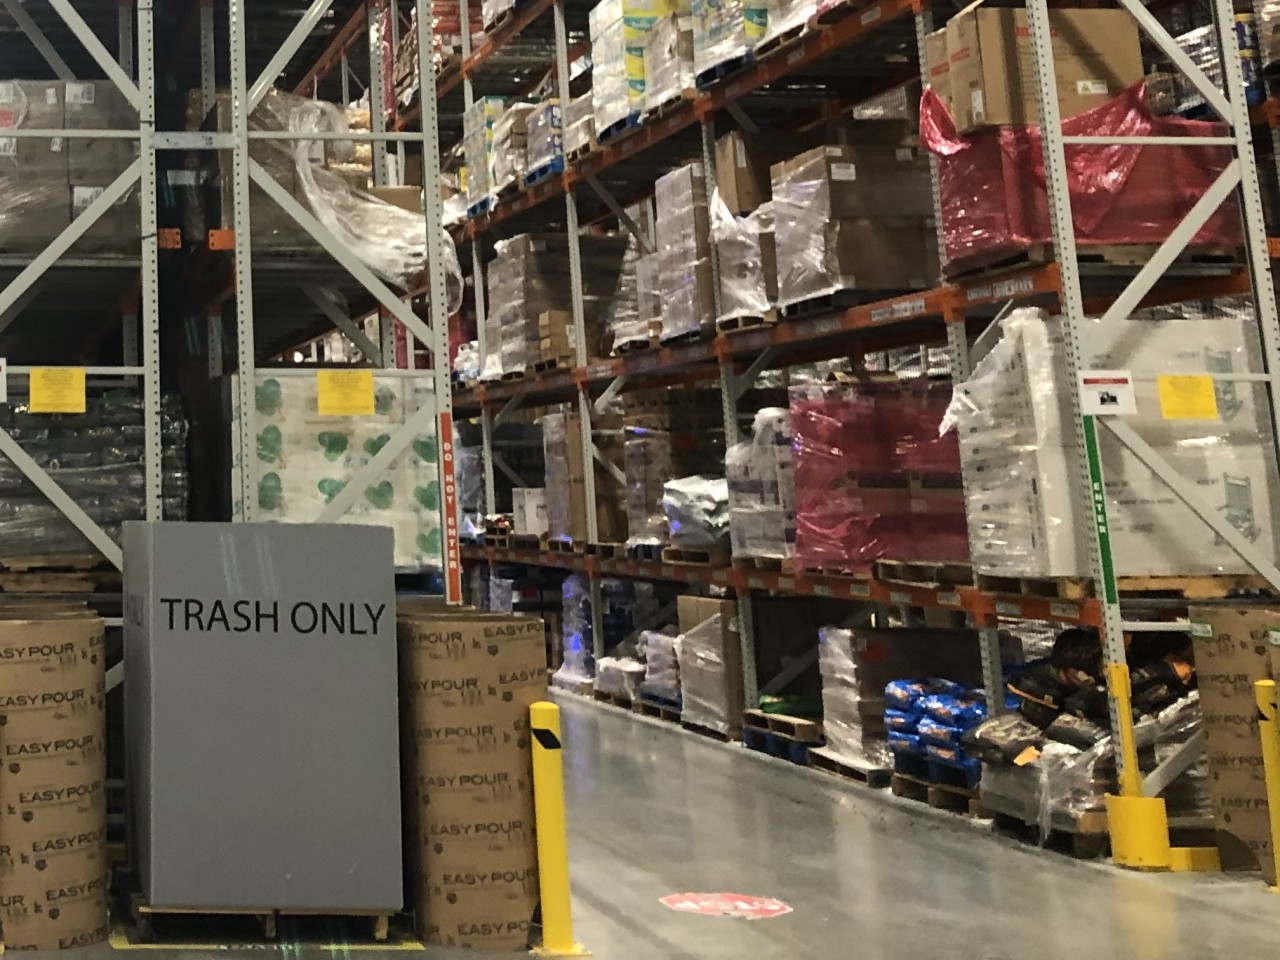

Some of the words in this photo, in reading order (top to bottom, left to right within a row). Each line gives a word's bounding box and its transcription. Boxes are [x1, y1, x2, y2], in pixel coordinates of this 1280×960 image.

[444, 442, 453, 461] DO
[446, 474, 455, 505] NOT
[1093, 481, 1107, 534] ENTER
[448, 517, 457, 570] ENTER
[160, 598, 279, 633] TRASH
[290, 600, 386, 635] ONLY
[418, 631, 463, 644] POUR
[28, 642, 75, 657] POUR
[431, 678, 478, 691] POUR
[41, 689, 85, 705] POUR
[445, 725, 494, 738] POUR
[6, 742, 52, 756] EASY
[54, 735, 93, 752] POUR
[459, 772, 508, 785] POUR
[19, 789, 66, 803] EASY
[67, 782, 101, 798] POUR
[431, 823, 472, 836] EASY
[475, 821, 523, 833] POUR
[32, 835, 77, 852] EASY
[443, 873, 487, 885] EASY
[45, 883, 85, 901] EASY
[458, 922, 503, 936] EASY
